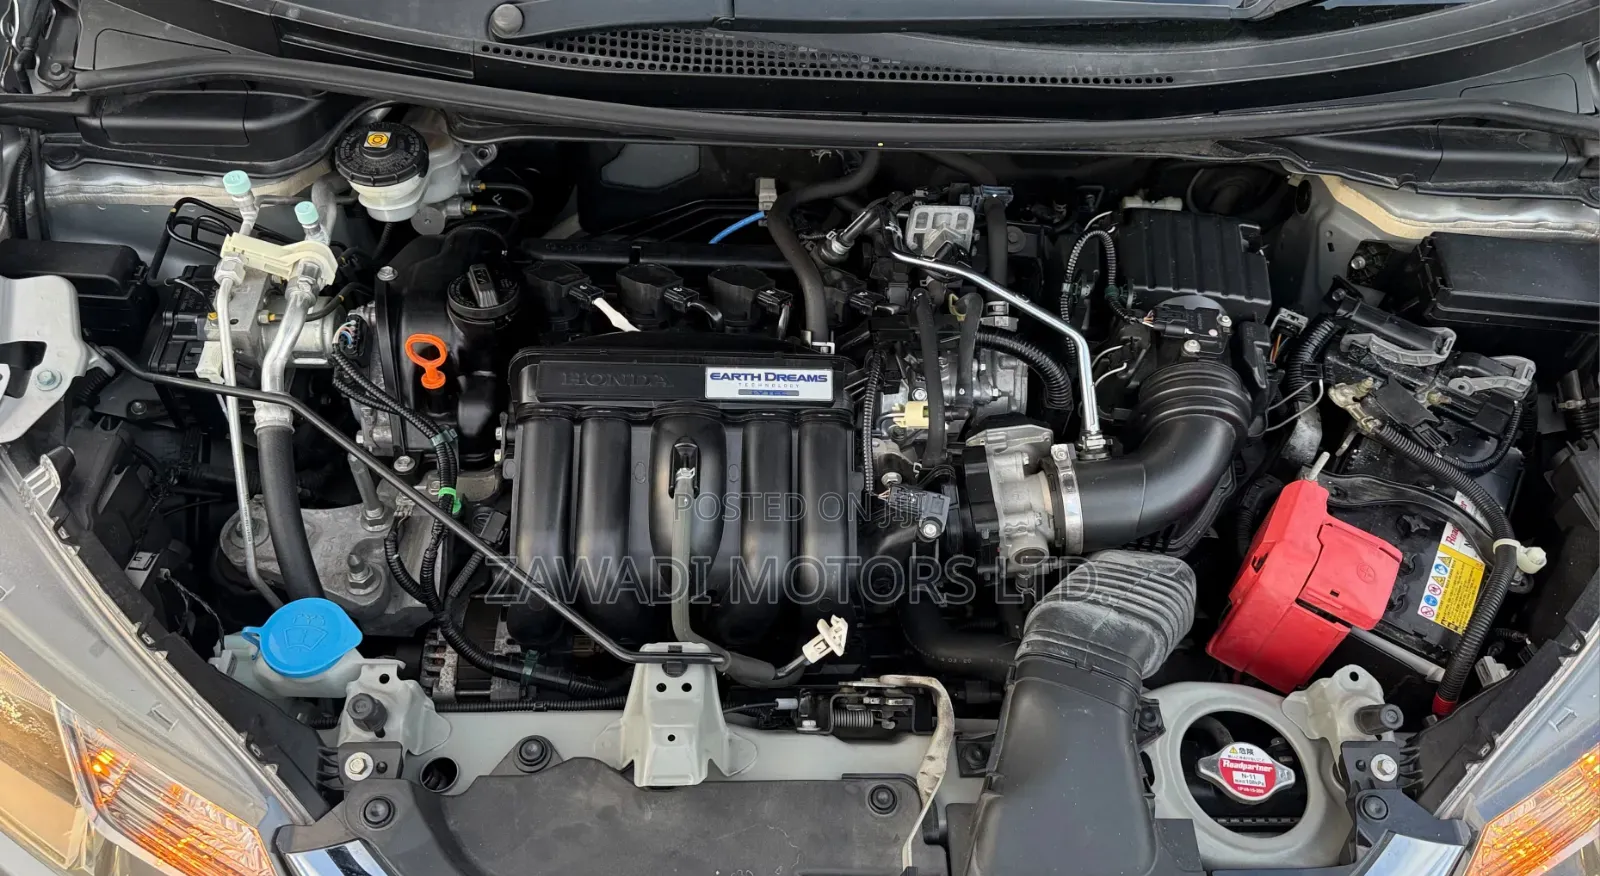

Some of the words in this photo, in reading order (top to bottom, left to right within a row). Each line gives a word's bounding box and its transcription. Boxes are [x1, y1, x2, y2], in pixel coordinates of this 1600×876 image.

[561, 372, 674, 388] HONDA
[710, 372, 761, 381] EARTH
[764, 372, 828, 383] DREAMS
[1238, 747, 1254, 756] 危険
[1222, 760, 1273, 772] Roadpartner
